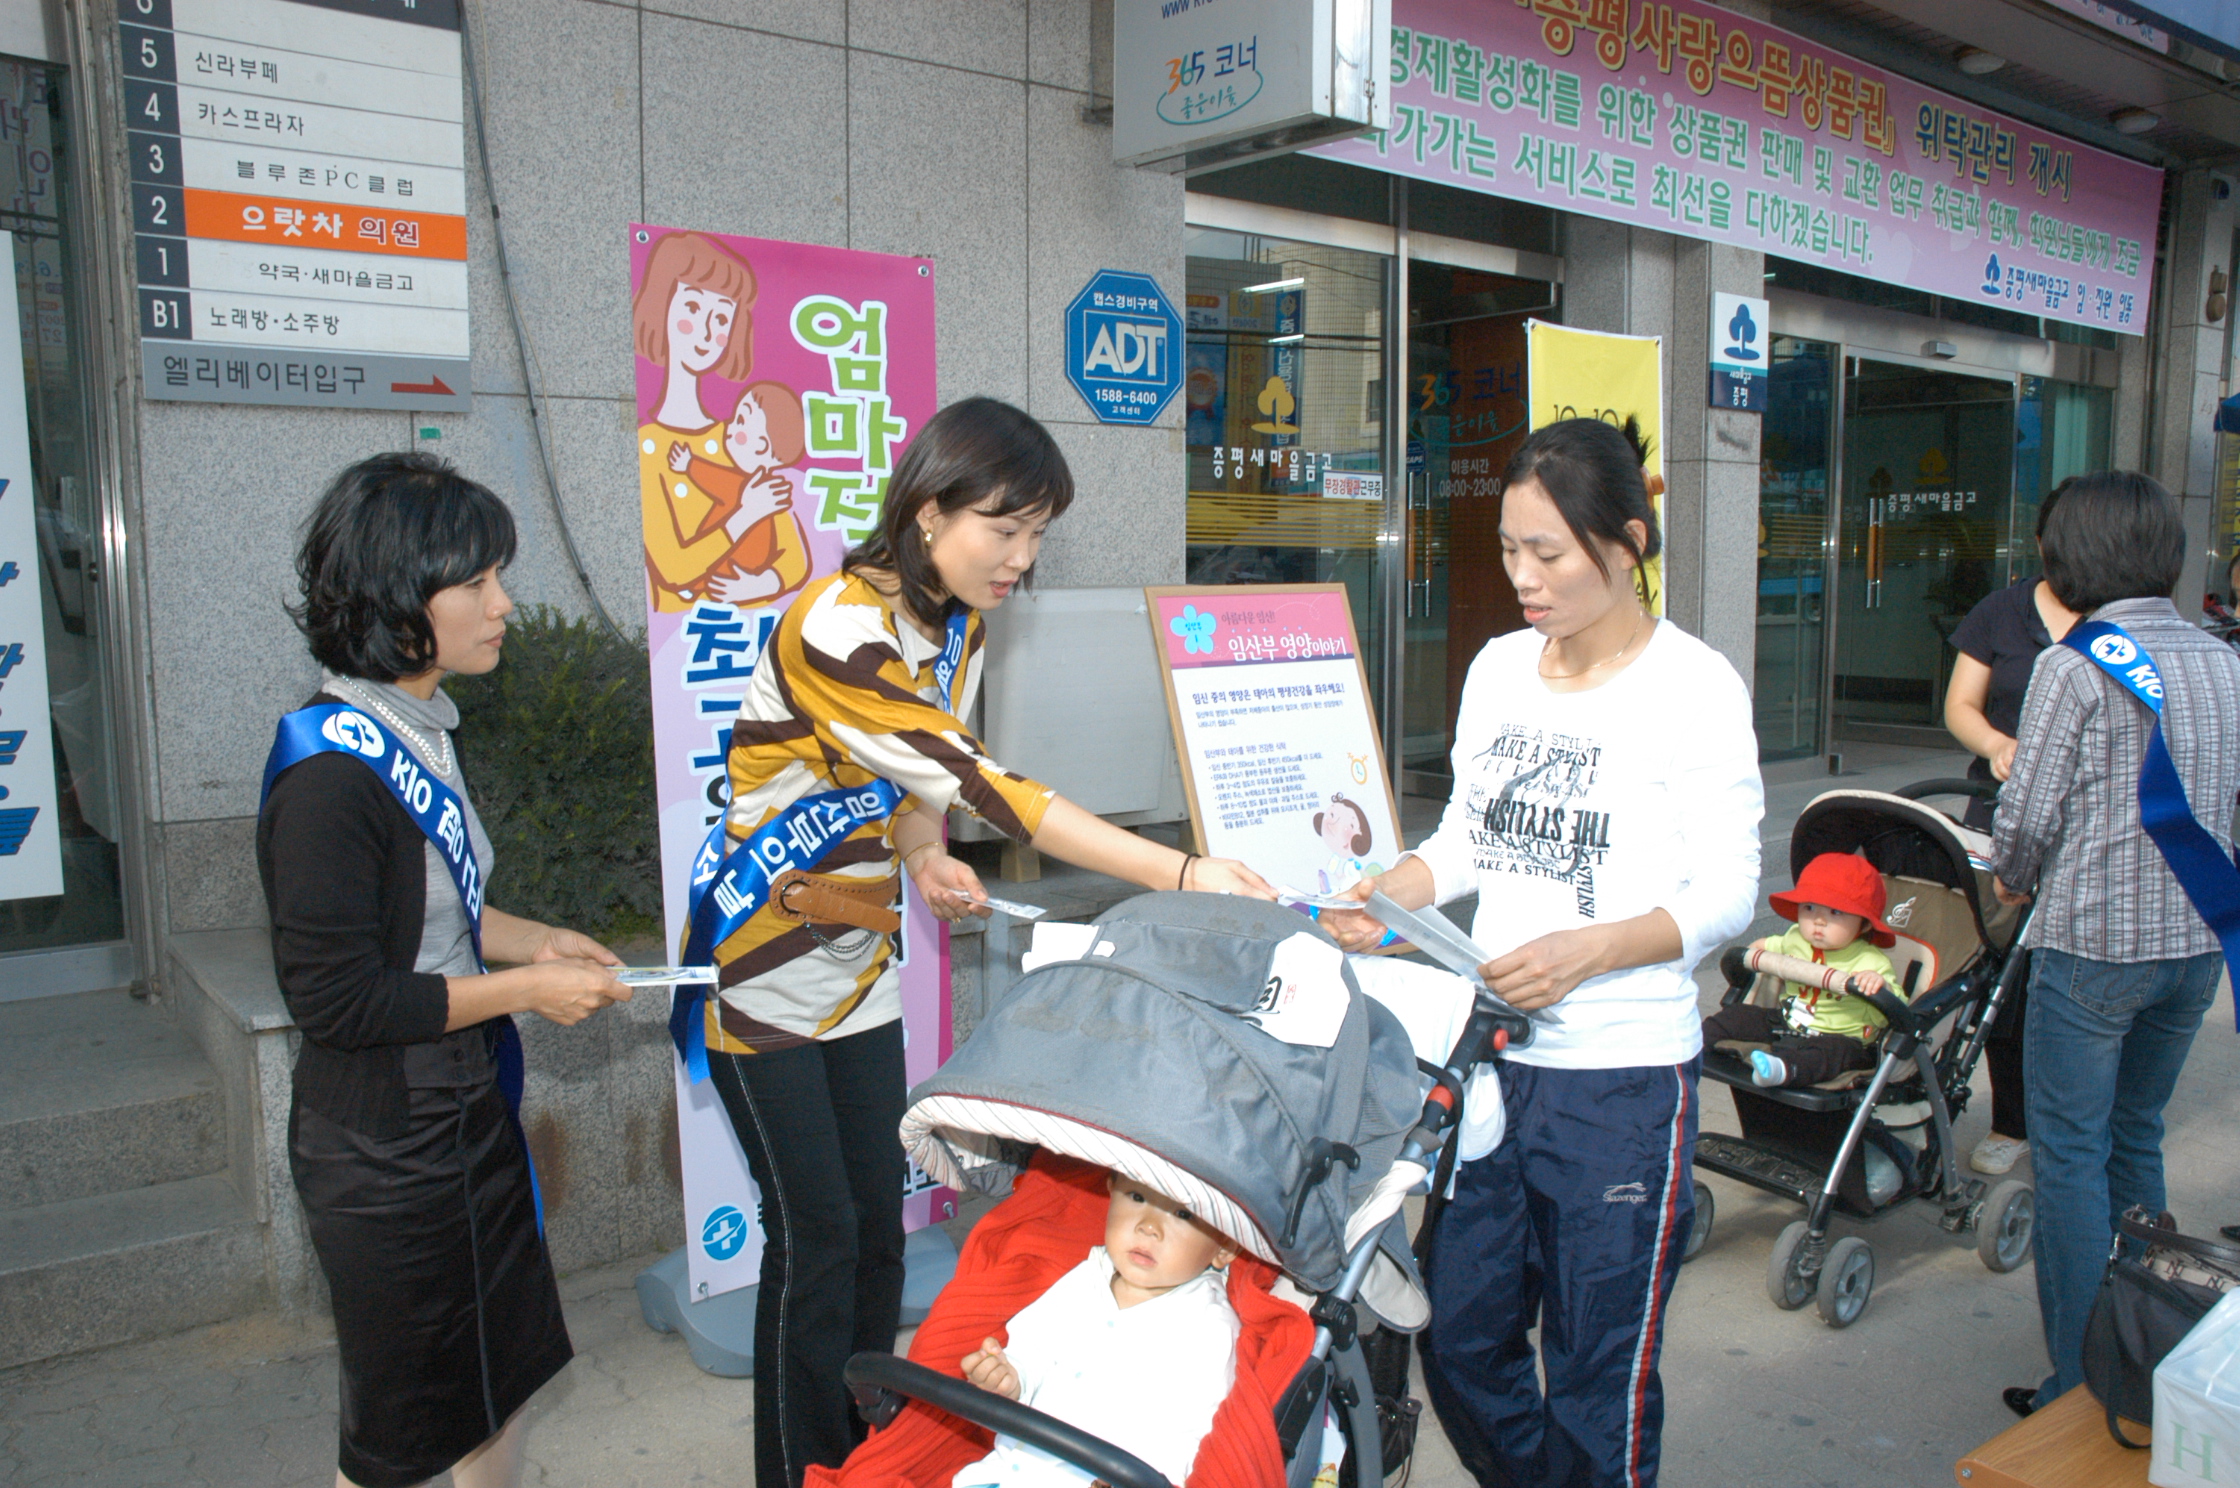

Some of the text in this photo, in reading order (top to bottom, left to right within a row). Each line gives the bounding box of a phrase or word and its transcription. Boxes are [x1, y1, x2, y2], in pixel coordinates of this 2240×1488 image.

[141, 38, 278, 84] 5 신라부페
[1164, 35, 1257, 95] 365 코너
[144, 92, 304, 136] 4 카스프라자
[1180, 85, 1237, 119] 좋은이웃
[149, 144, 164, 174] 3
[1915, 102, 2016, 185] 위탁관리
[2028, 142, 2072, 202] 개시
[1598, 83, 1656, 147] 위한
[1669, 104, 1747, 170] 상품권
[1761, 128, 1803, 185] 판매
[1814, 146, 1833, 195] 및
[1843, 156, 1881, 209] 교환
[1889, 170, 1924, 220] 업무
[1931, 182, 1981, 238] 취급과
[2115, 237, 2141, 278] 조금
[1513, 132, 1637, 210] 서비스로
[1651, 162, 1731, 230] 최선을
[1745, 188, 1873, 264] 다하겠습니다.
[151, 195, 419, 248] 2 으랏차 의원
[158, 248, 168, 276] 1
[1093, 292, 1158, 312] 캡스경비구역
[2005, 265, 2069, 309] 증평새마을금고
[153, 299, 179, 329] B1
[1085, 322, 1167, 376] ADT
[163, 355, 365, 394] 엘리베이터입구
[1418, 361, 1520, 411] 365 코너
[1095, 389, 1157, 405] 1588-6400
[1733, 386, 1748, 407] 증평
[1439, 410, 1500, 437] 은이웃
[1213, 446, 1332, 482] 증평새마을금고
[1451, 458, 1489, 475] 이용시간
[1439, 478, 1500, 497] 08:00~23:00
[1888, 492, 1976, 512] 증평새마을금고
[1221, 611, 1255, 626] 아름다운
[1228, 635, 1279, 662] 임산부
[1191, 692, 1209, 704] 임신
[1209, 691, 1226, 703] 중의
[1484, 798, 1564, 841] STYLISH
[1569, 809, 1610, 848] THE
[749, 791, 887, 886] 임산부의
[1468, 829, 1504, 847] AKE
[1506, 835, 1519, 851] A
[1474, 859, 1504, 872] AKE
[1509, 863, 1519, 873] A
[1524, 865, 1576, 885] STYLIST
